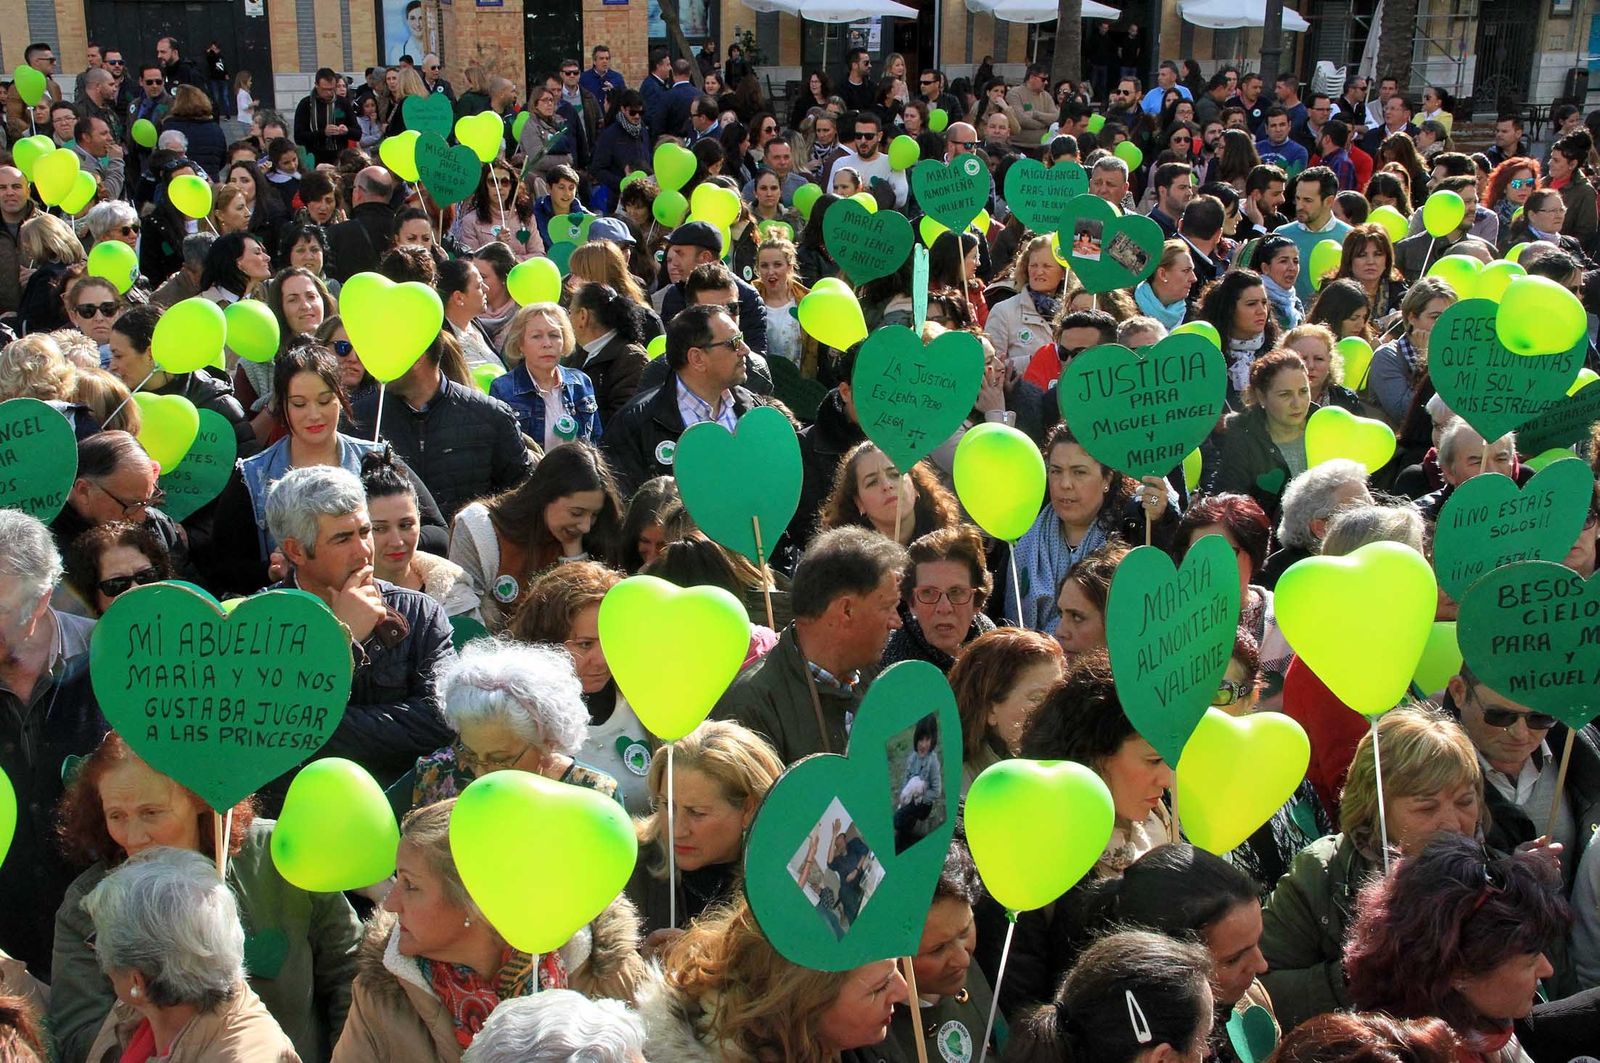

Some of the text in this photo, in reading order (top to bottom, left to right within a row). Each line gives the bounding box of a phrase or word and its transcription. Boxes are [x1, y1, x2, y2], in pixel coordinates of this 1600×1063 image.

[425, 143, 459, 162] MIGUEL
[439, 160, 469, 176] ANGEL
[934, 196, 976, 214] VALIENTE
[1025, 200, 1037, 208] NO
[1051, 201, 1066, 209] OLVI
[1032, 213, 1062, 224] ALMON
[1451, 317, 1496, 342] ERES
[1441, 347, 1478, 367] QUE
[882, 356, 956, 393] LA JUSTICIA
[1078, 352, 1206, 402] JUSTICIA
[1454, 369, 1478, 390] MI
[1486, 373, 1514, 392] SOL
[872, 384, 887, 400] ES
[1130, 387, 1178, 409] PARA
[873, 411, 904, 432] LLEGA
[1092, 404, 1216, 441] MIGUEL ANGEL
[200, 431, 218, 443] NO
[1127, 442, 1184, 469] MARIA
[1498, 577, 1585, 609] BESOS
[1523, 600, 1600, 625] CIELO
[127, 614, 308, 659] MI ABUELITA
[1137, 592, 1229, 682] ALMONTEÑA
[1492, 632, 1551, 655] PARA
[232, 668, 244, 686] Y
[257, 667, 283, 688] YO
[297, 671, 337, 693] NOS
[1154, 642, 1224, 708] VALIENTE
[1509, 670, 1585, 693] MIGUEL
[144, 697, 329, 731] GUSTABA JUGAR
[146, 724, 325, 750] A LAS PRINCESAS
